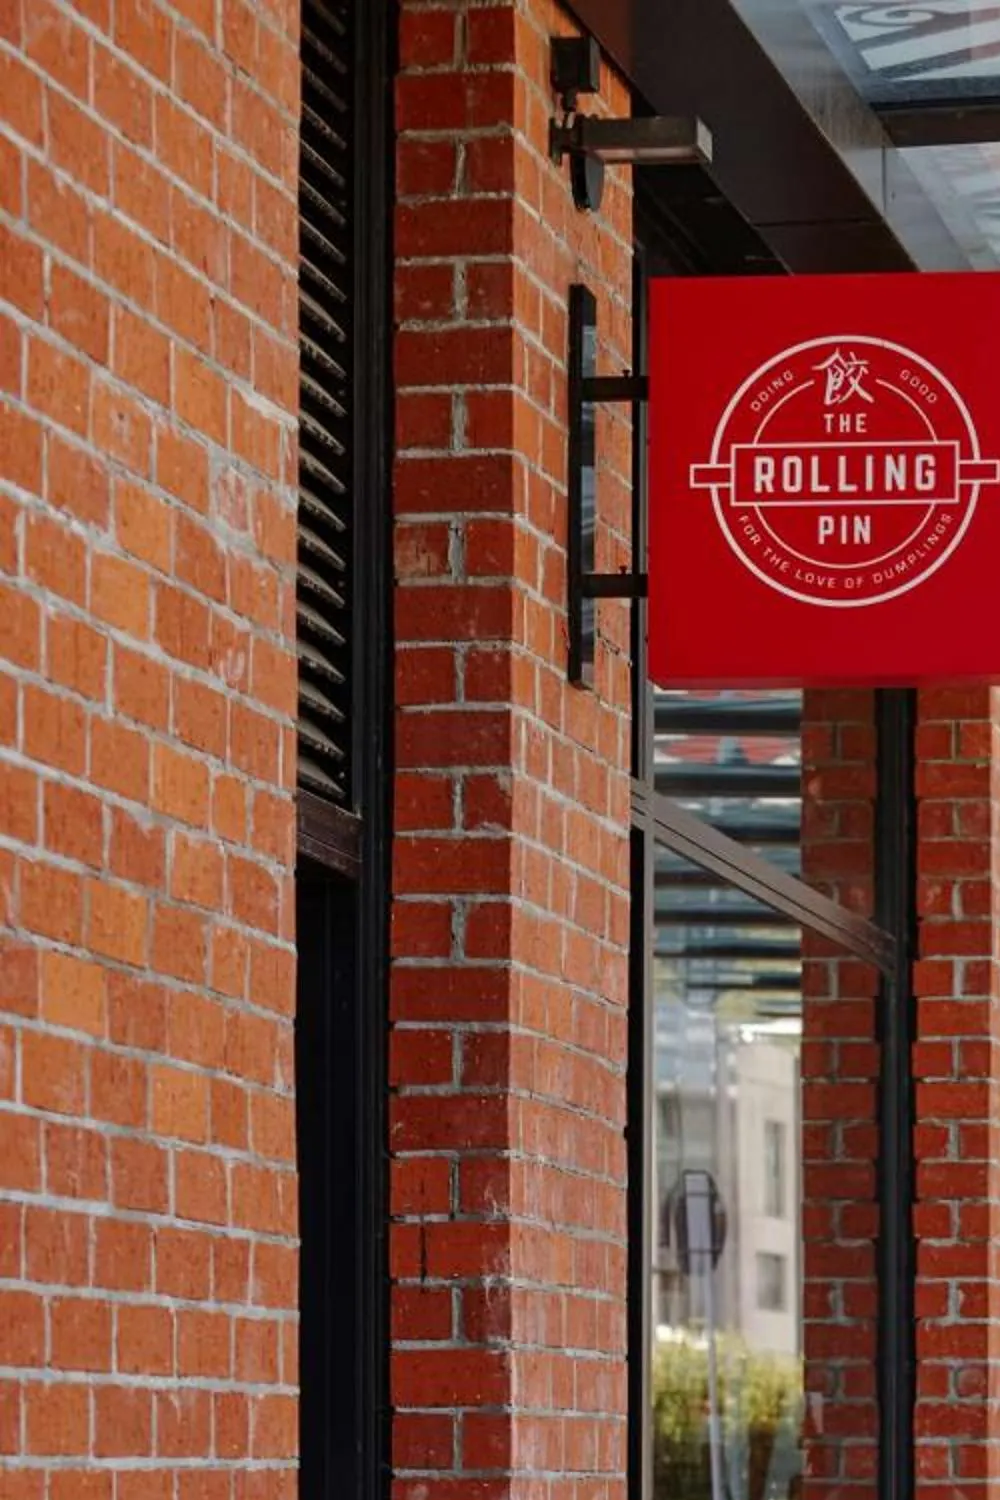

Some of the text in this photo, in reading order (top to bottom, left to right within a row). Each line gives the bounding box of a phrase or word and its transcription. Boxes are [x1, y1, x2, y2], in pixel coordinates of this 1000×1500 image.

[750, 369, 938, 411] DOING GOOD
[824, 413, 867, 433] THE
[754, 454, 936, 493] ROLLING
[818, 515, 871, 545] PIN
[738, 512, 953, 589] FOR THE LOVE OF DUMPLINGS
